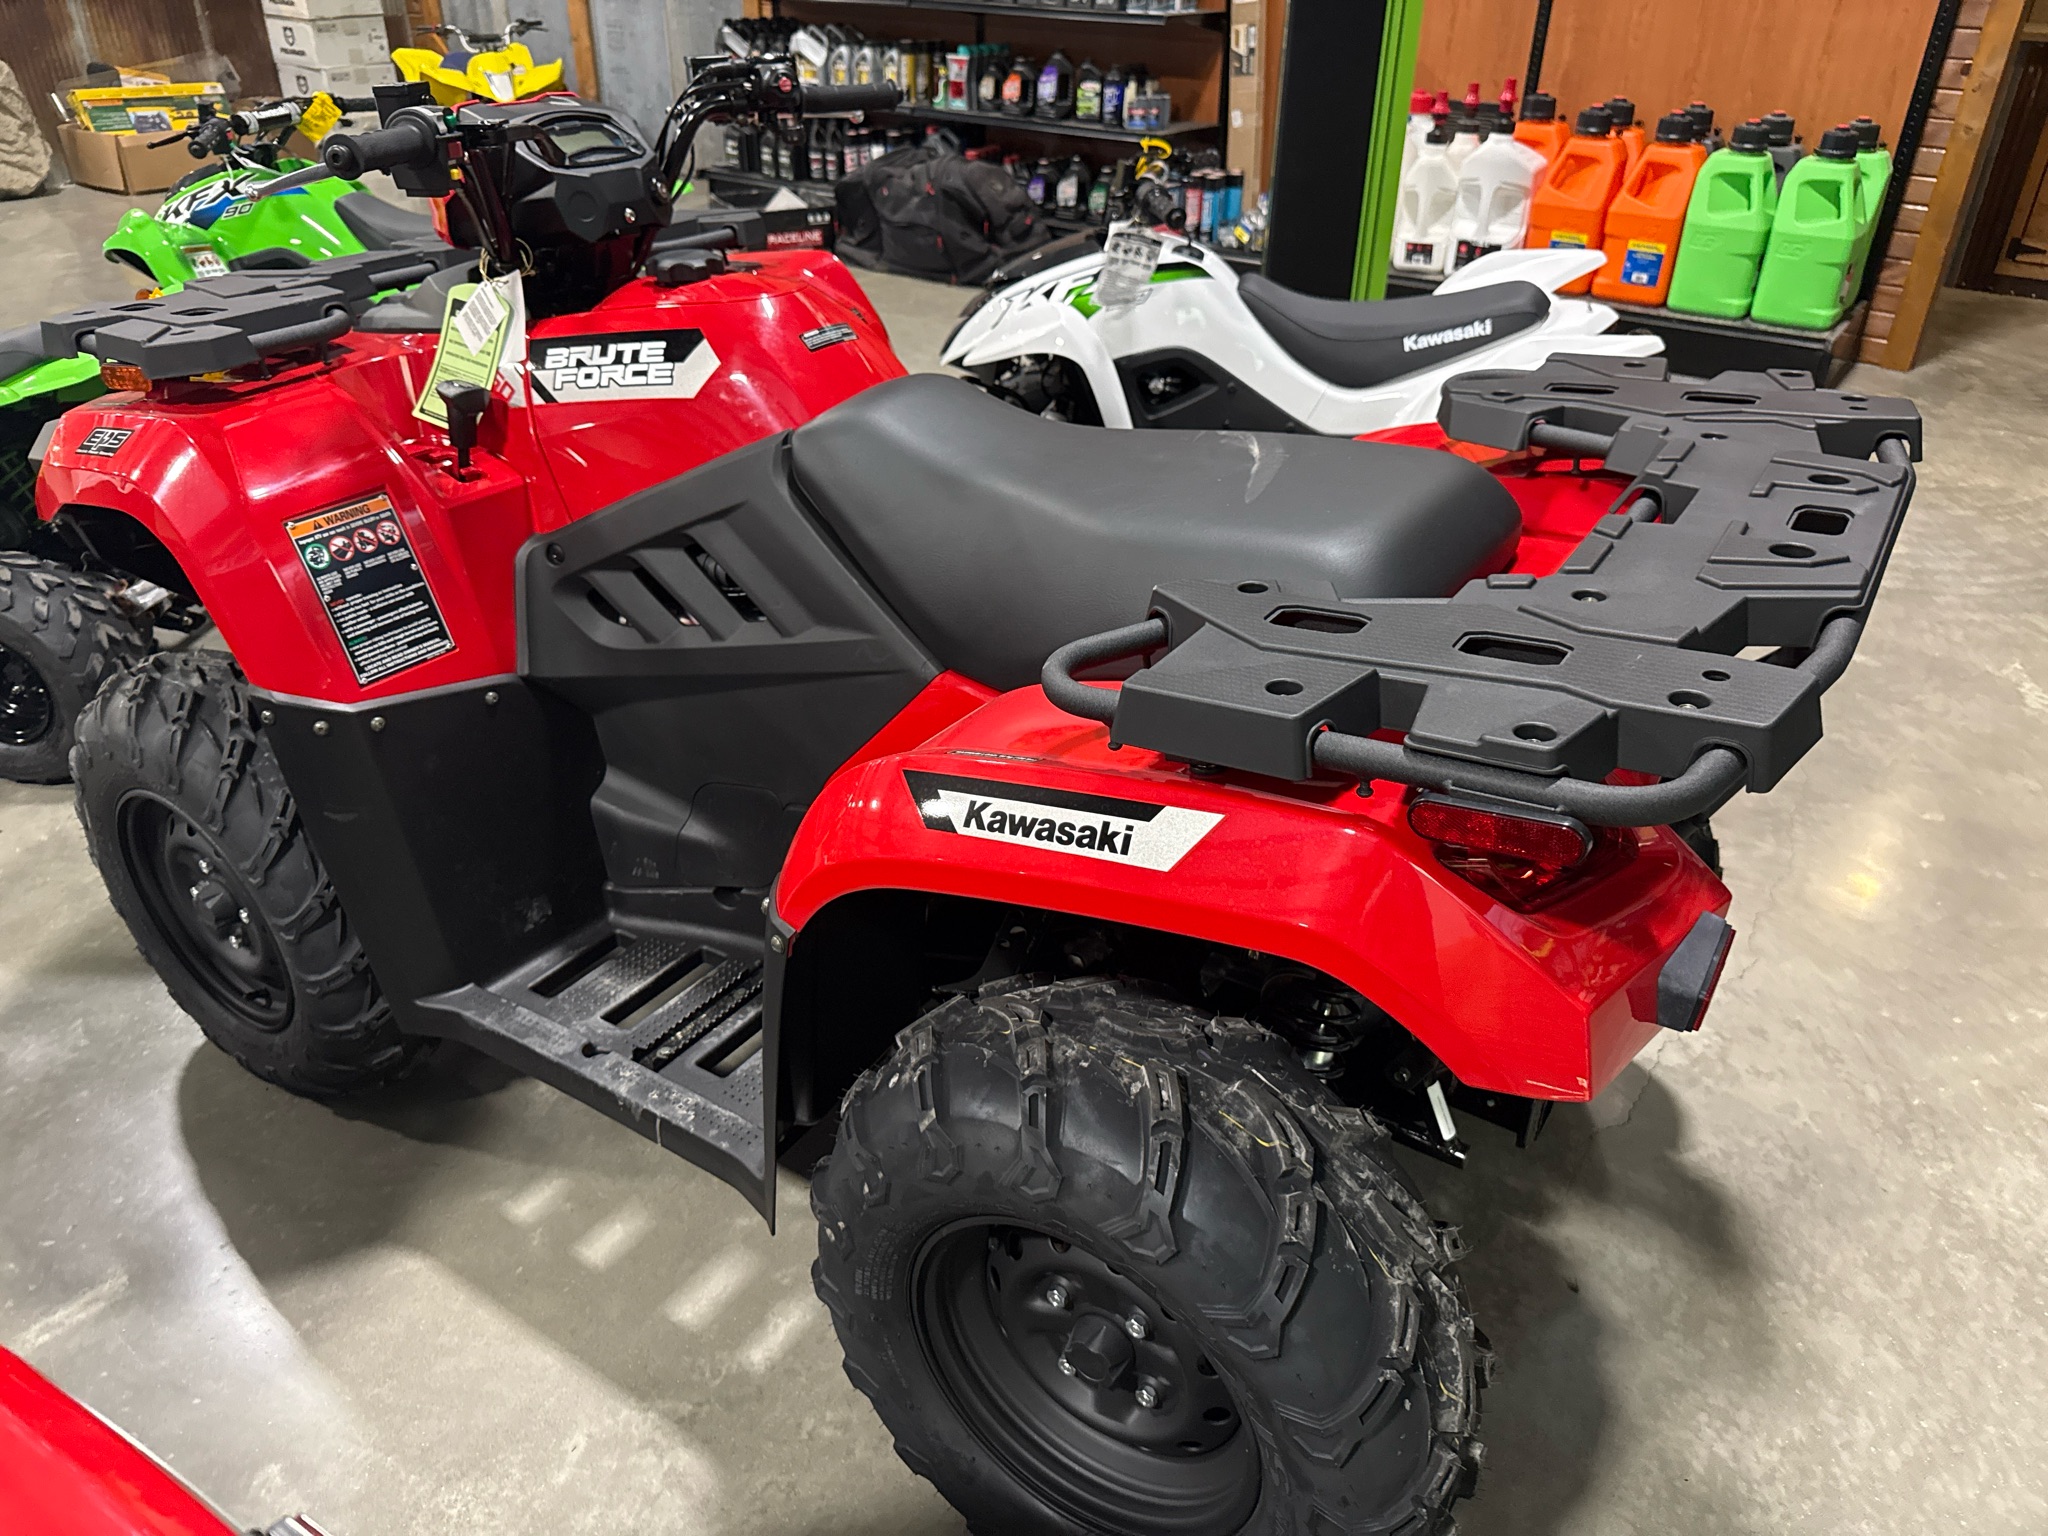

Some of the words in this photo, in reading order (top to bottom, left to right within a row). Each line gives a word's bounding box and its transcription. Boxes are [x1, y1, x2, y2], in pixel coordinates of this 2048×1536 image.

[222, 202, 254, 219] 90
[1402, 318, 1492, 352] Kawasaki
[544, 341, 667, 369] BRUTE
[553, 362, 674, 390] FORCE
[323, 504, 371, 526] WARNING
[963, 799, 1135, 856] Kawasaki
